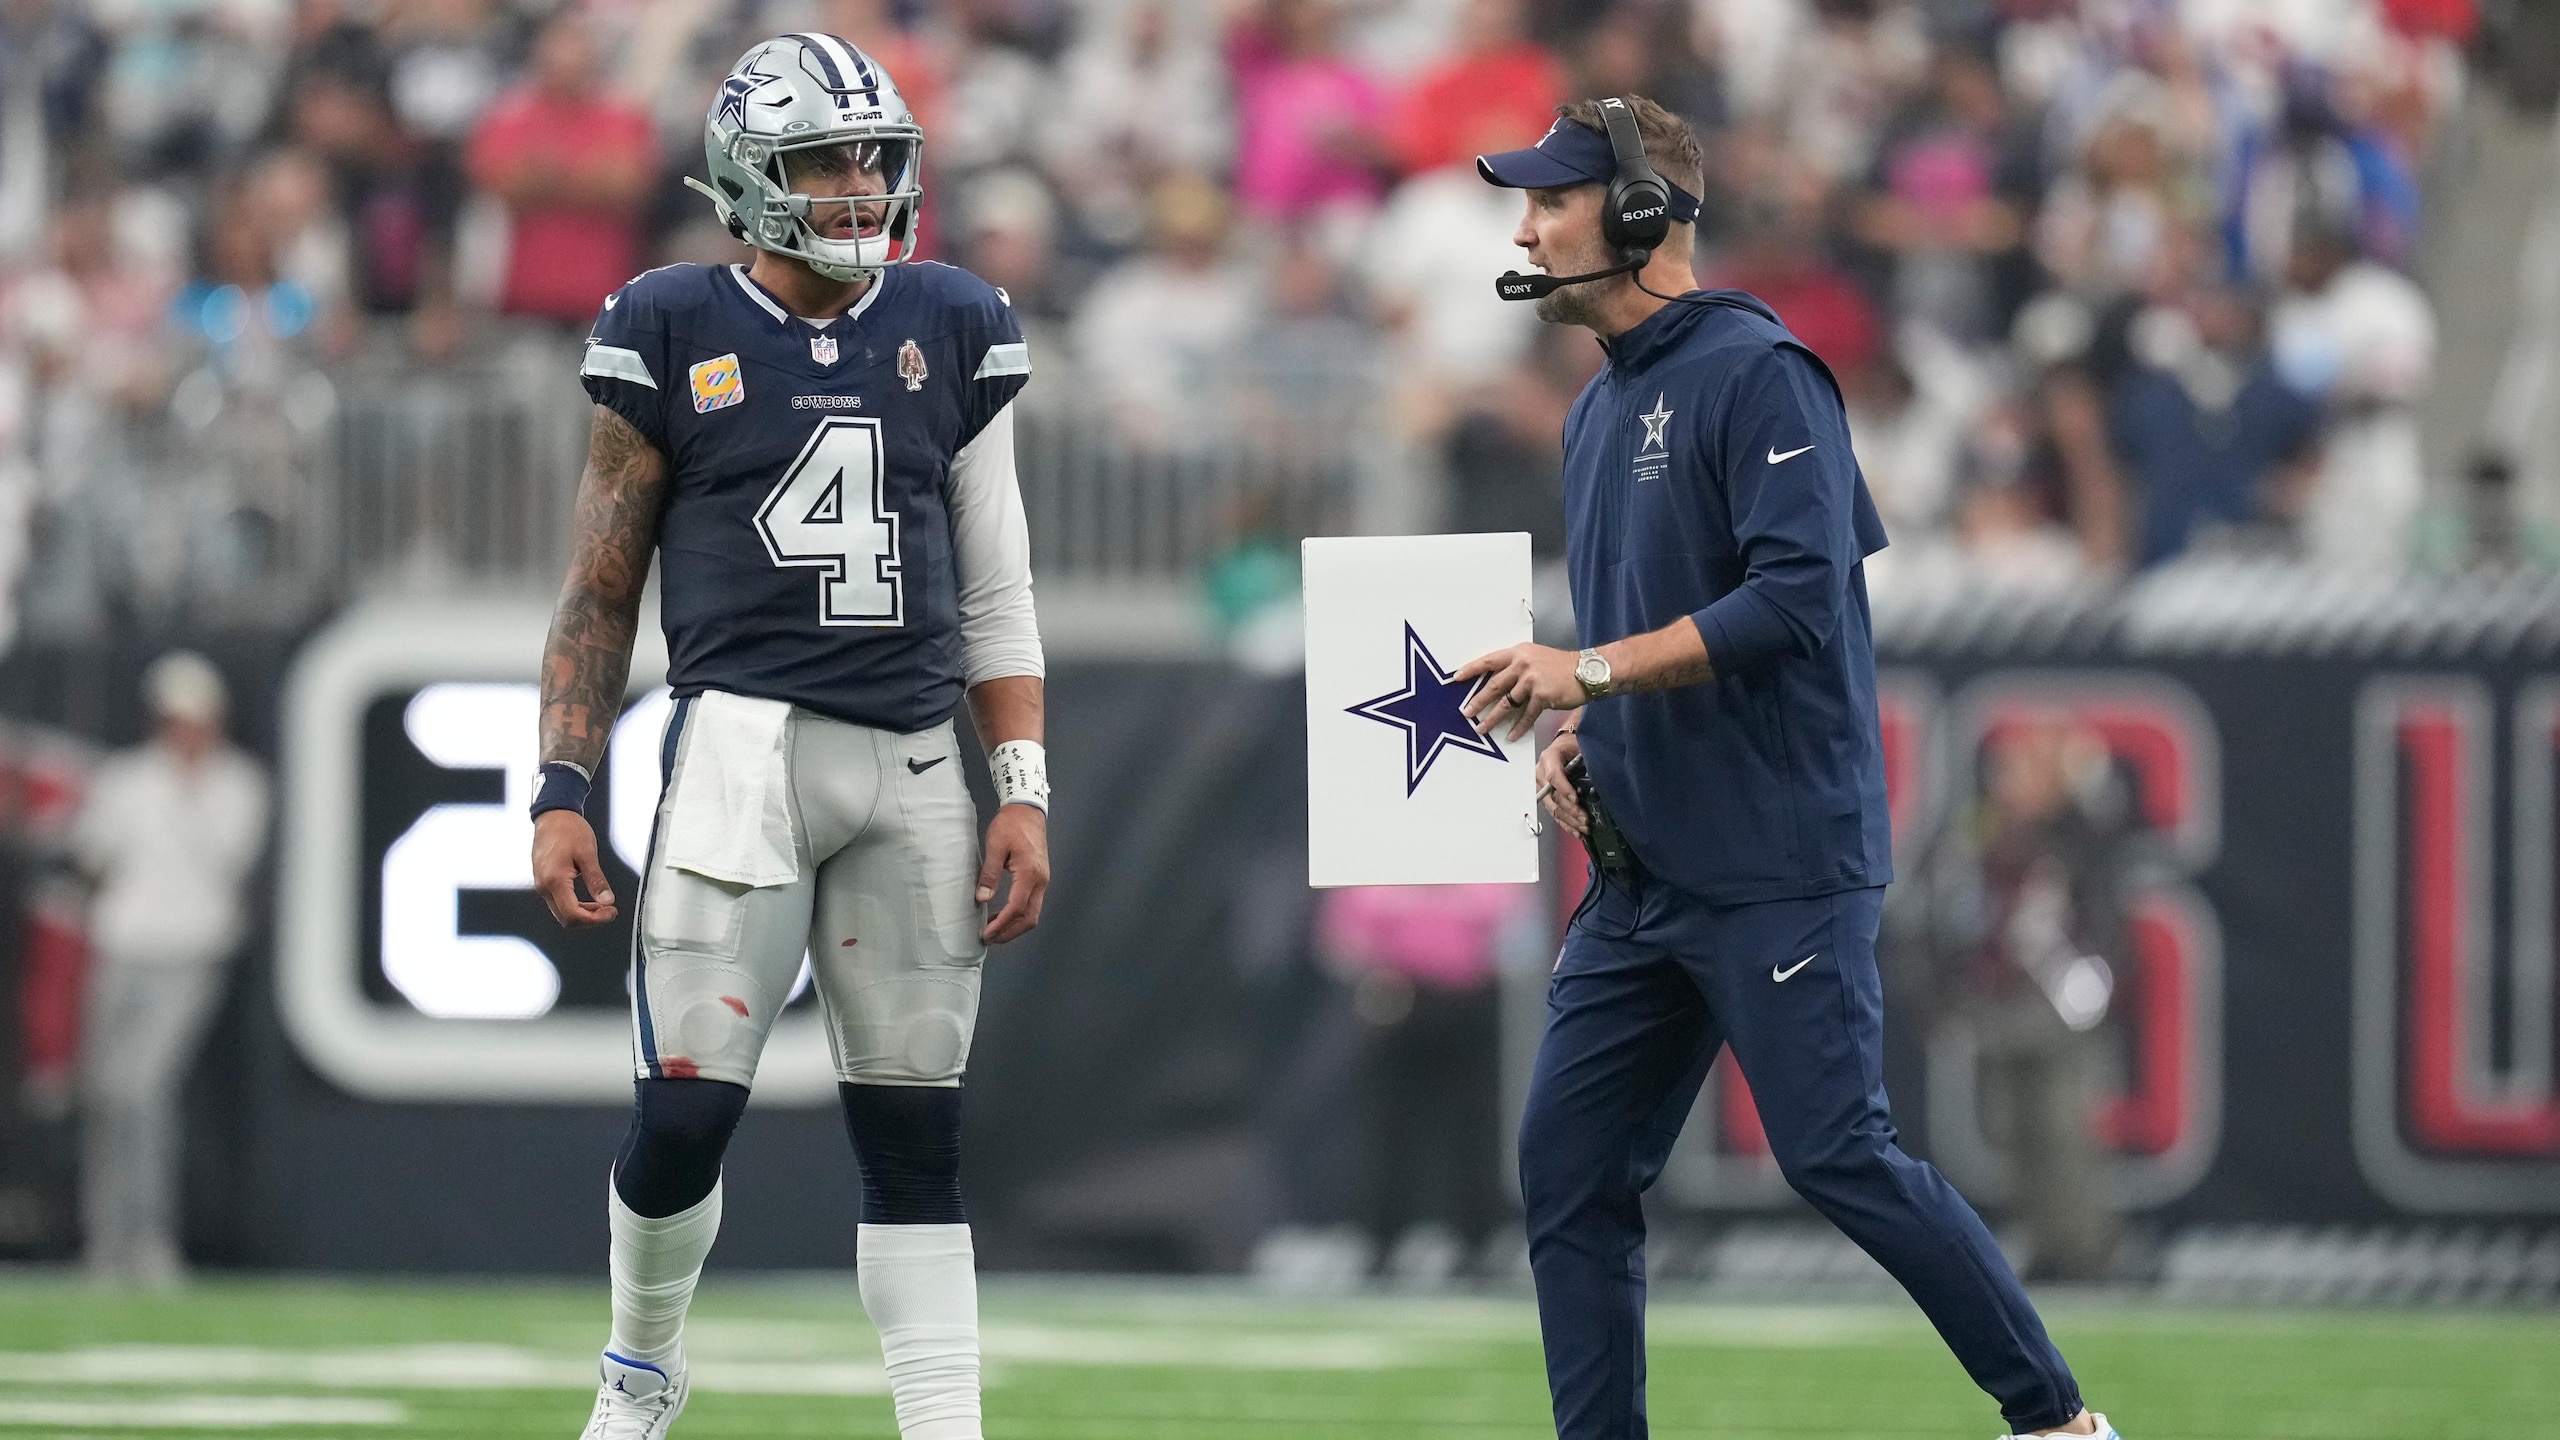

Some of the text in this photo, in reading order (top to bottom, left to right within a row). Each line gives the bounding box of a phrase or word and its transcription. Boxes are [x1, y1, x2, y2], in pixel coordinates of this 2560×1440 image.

[1622, 205, 1665, 221] SONY
[1503, 283, 1532, 294] SONY
[816, 348, 834, 360] NFL
[792, 396, 861, 409] COWBOYS
[752, 416, 904, 626] 4
